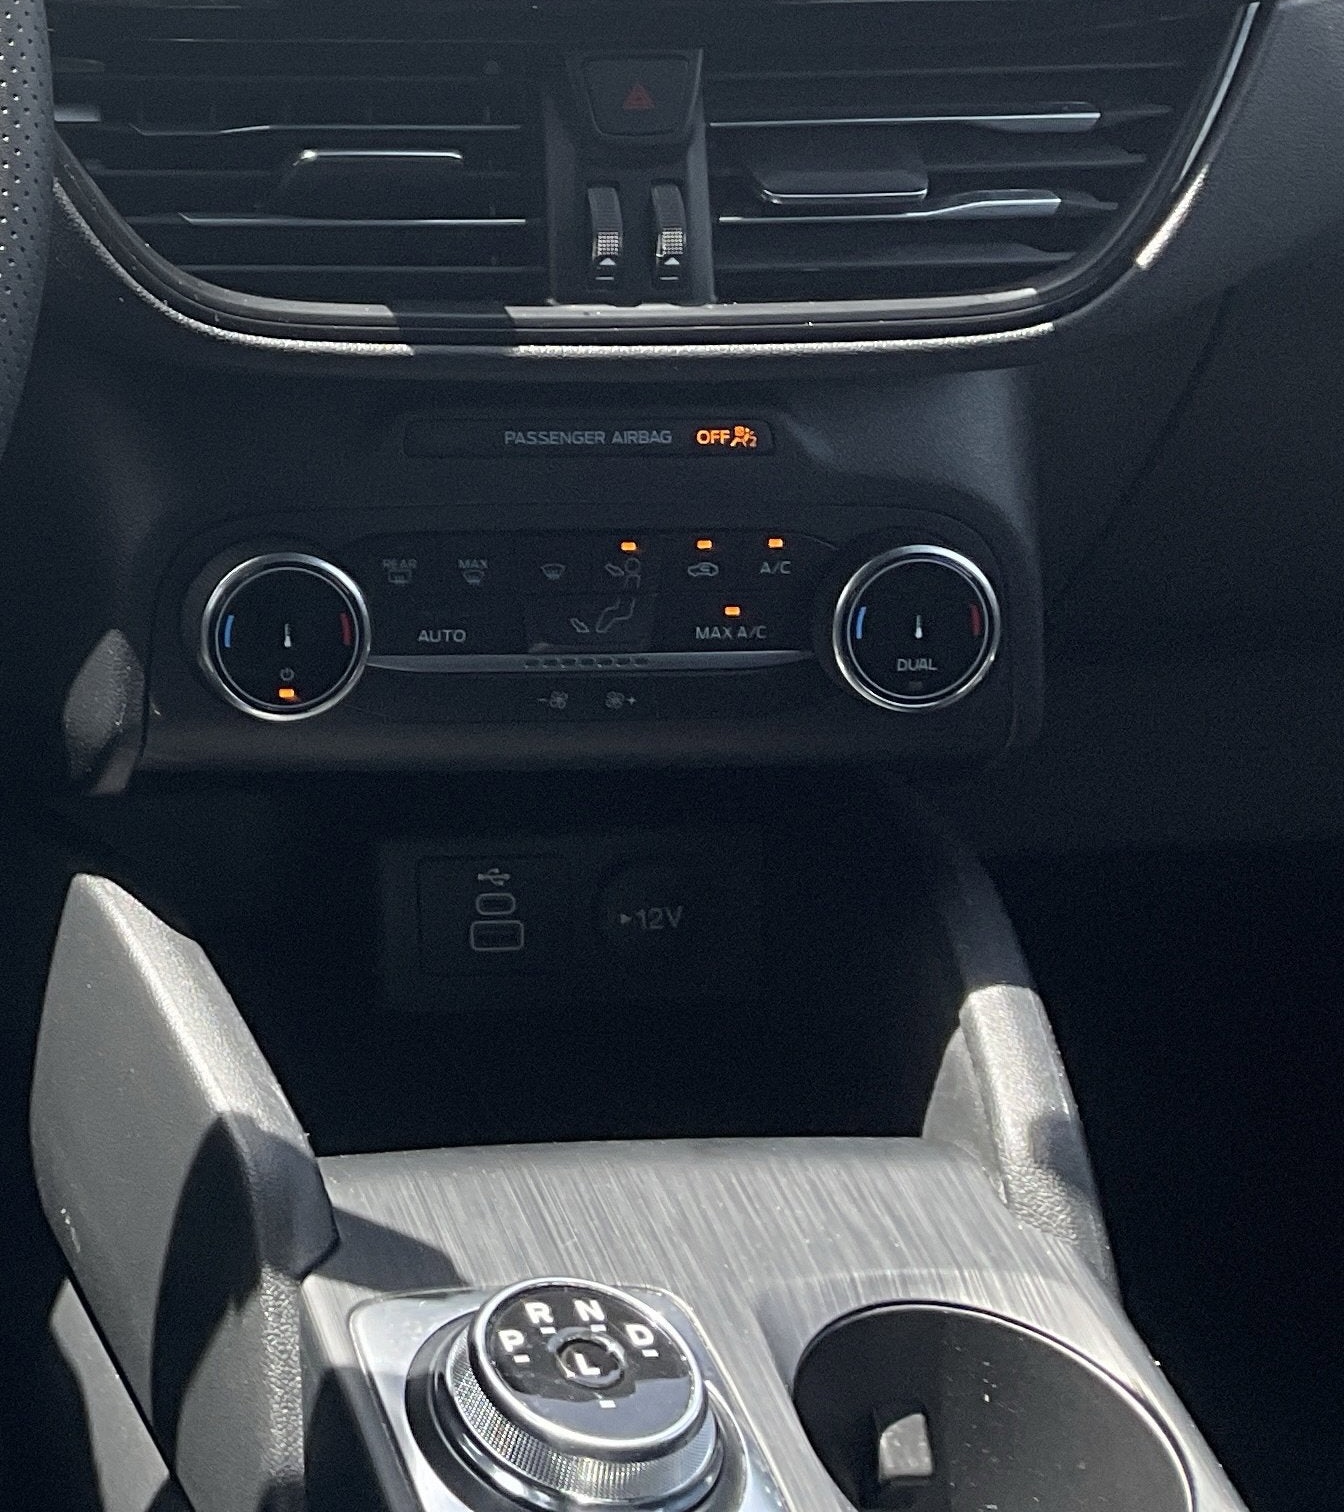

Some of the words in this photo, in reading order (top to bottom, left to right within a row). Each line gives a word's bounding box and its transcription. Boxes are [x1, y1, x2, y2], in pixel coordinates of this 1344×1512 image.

[504, 431, 605, 445] PASSENGER
[611, 430, 672, 444] AIRBAG
[696, 430, 729, 445] OFF
[383, 559, 417, 569] REAR
[458, 559, 488, 569] MAX
[760, 560, 791, 574] A/C
[418, 629, 466, 643] AUTO
[695, 626, 732, 640] MAX
[737, 625, 766, 639] A/C
[897, 658, 937, 671] DUAL
[637, 906, 683, 930] 12V
[525, 1303, 554, 1323] R
[574, 1300, 605, 1321] N
[499, 1330, 526, 1353] P
[626, 1324, 655, 1346] D
[574, 1353, 600, 1376] L
